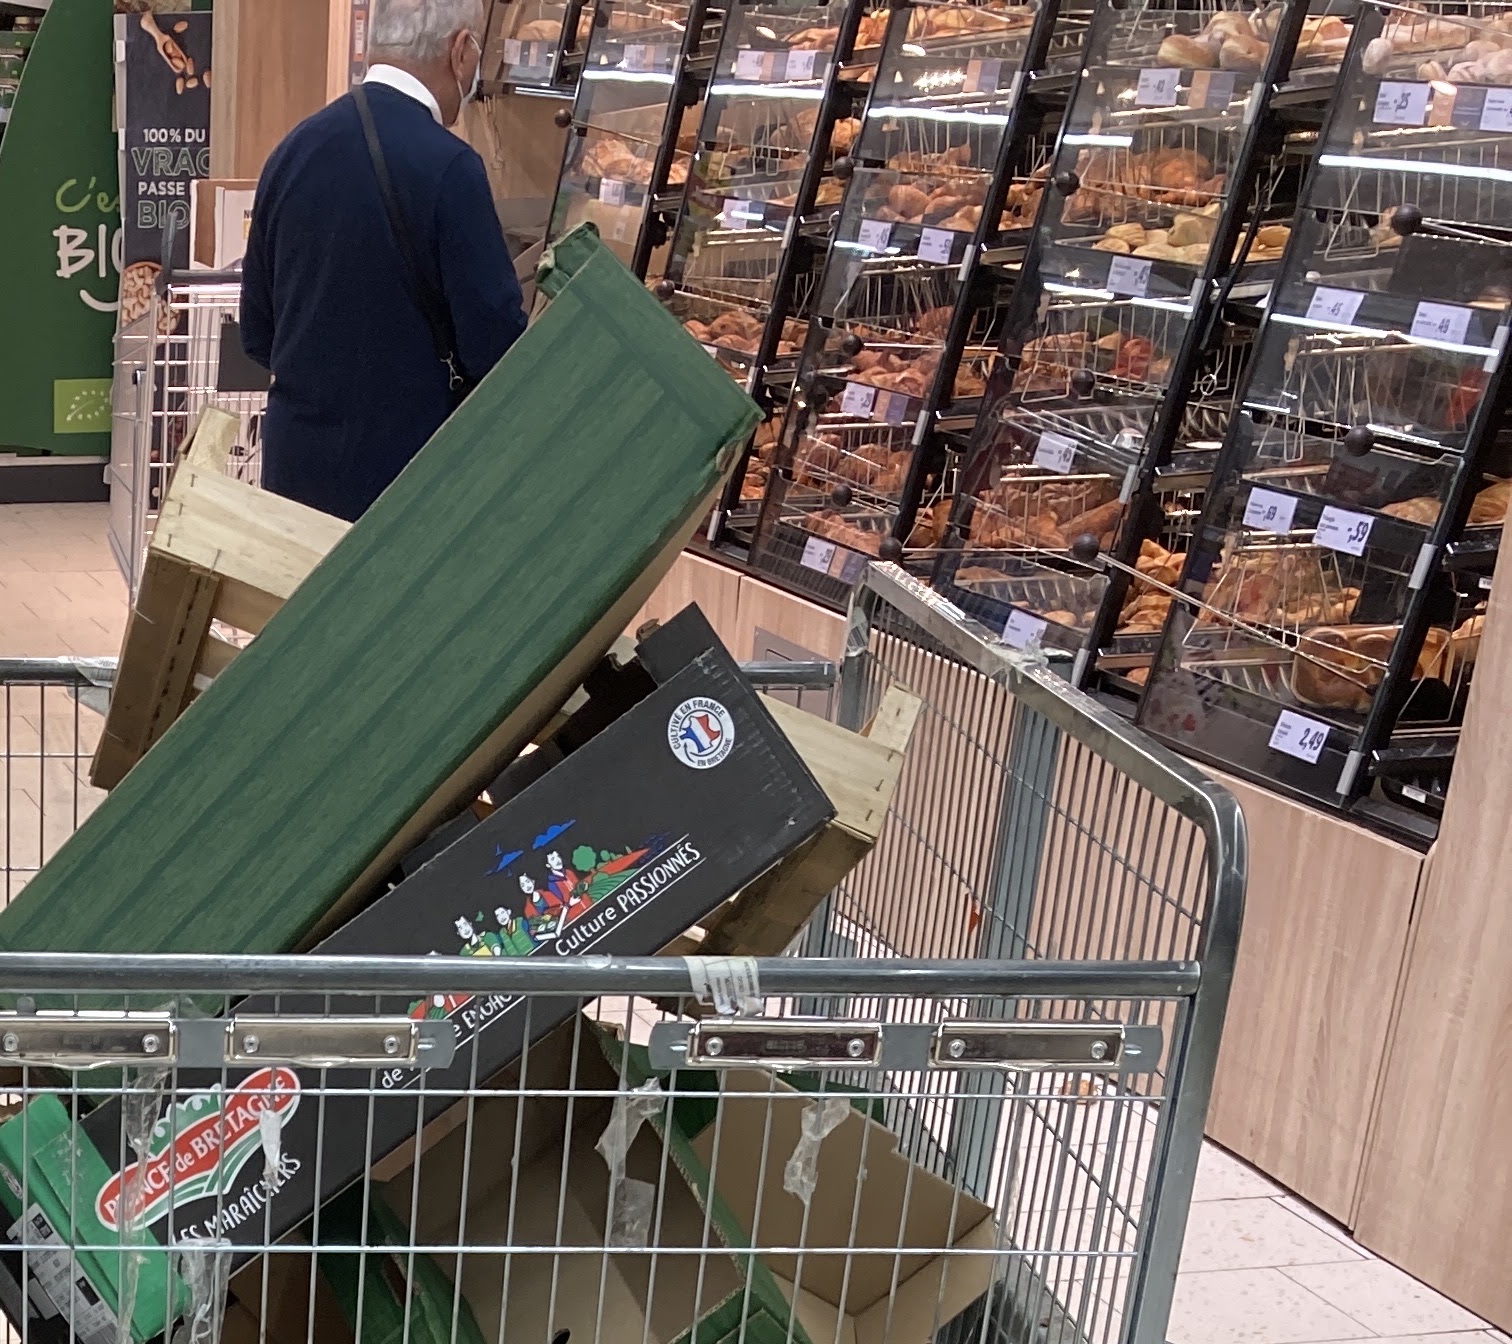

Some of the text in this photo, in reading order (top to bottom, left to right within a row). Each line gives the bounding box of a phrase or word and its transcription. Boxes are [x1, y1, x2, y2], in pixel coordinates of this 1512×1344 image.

[142, 128, 206, 143] 100% DU
[55, 176, 120, 213] C'e
[137, 181, 186, 196] PASSE
[137, 200, 191, 230] BIO
[679, 702, 692, 715] EN
[692, 699, 726, 718] FRANCE
[1298, 727, 1325, 751] 2,49
[381, 1067, 404, 1089] de
[555, 906, 617, 956] Culture
[616, 841, 701, 914] PASSIONNÉS
[103, 1162, 171, 1223] PNCE
[174, 1150, 196, 1173] de
